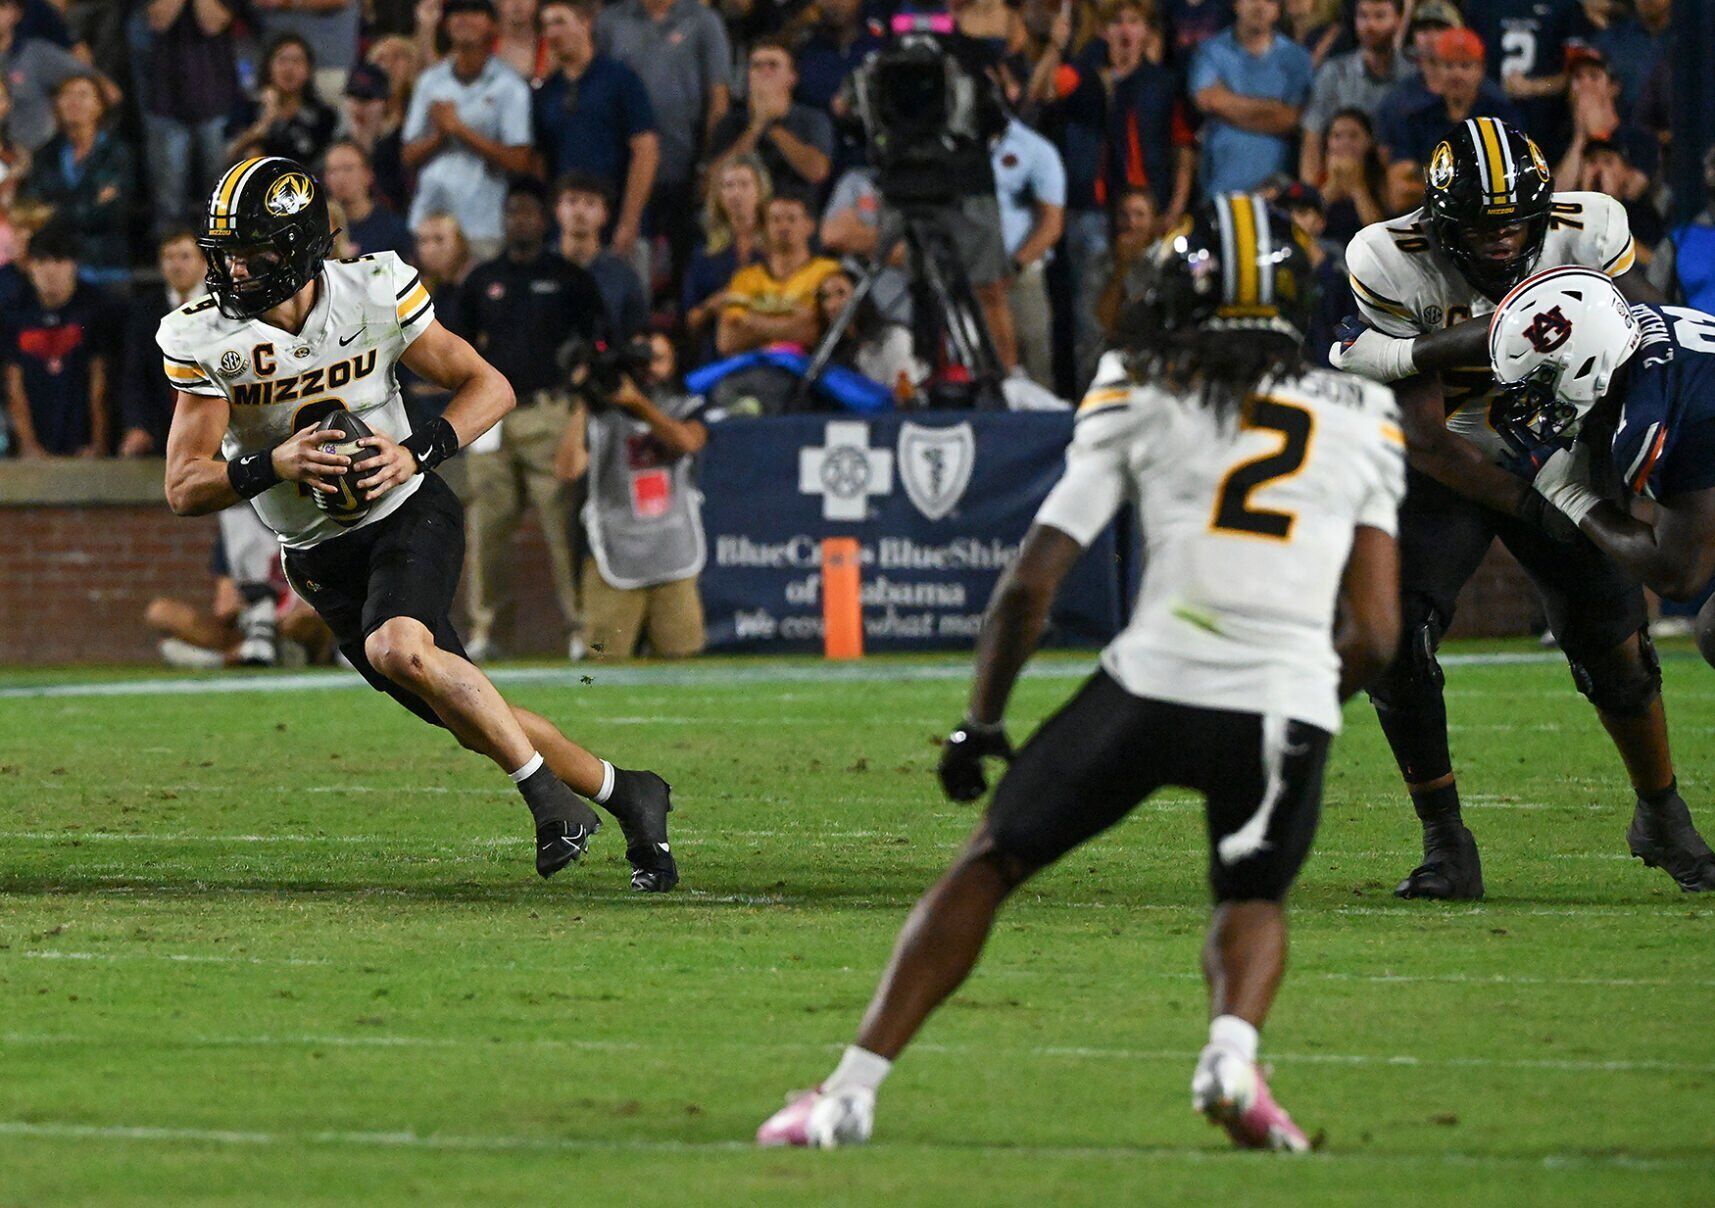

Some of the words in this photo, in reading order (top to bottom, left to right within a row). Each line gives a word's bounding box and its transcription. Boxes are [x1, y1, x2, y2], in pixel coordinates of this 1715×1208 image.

[222, 351, 240, 370] SEC
[251, 342, 278, 377] C
[232, 349, 378, 406] MIZZOU
[1209, 394, 1316, 543] 2
[786, 573, 820, 605] of
[861, 575, 966, 607] abama
